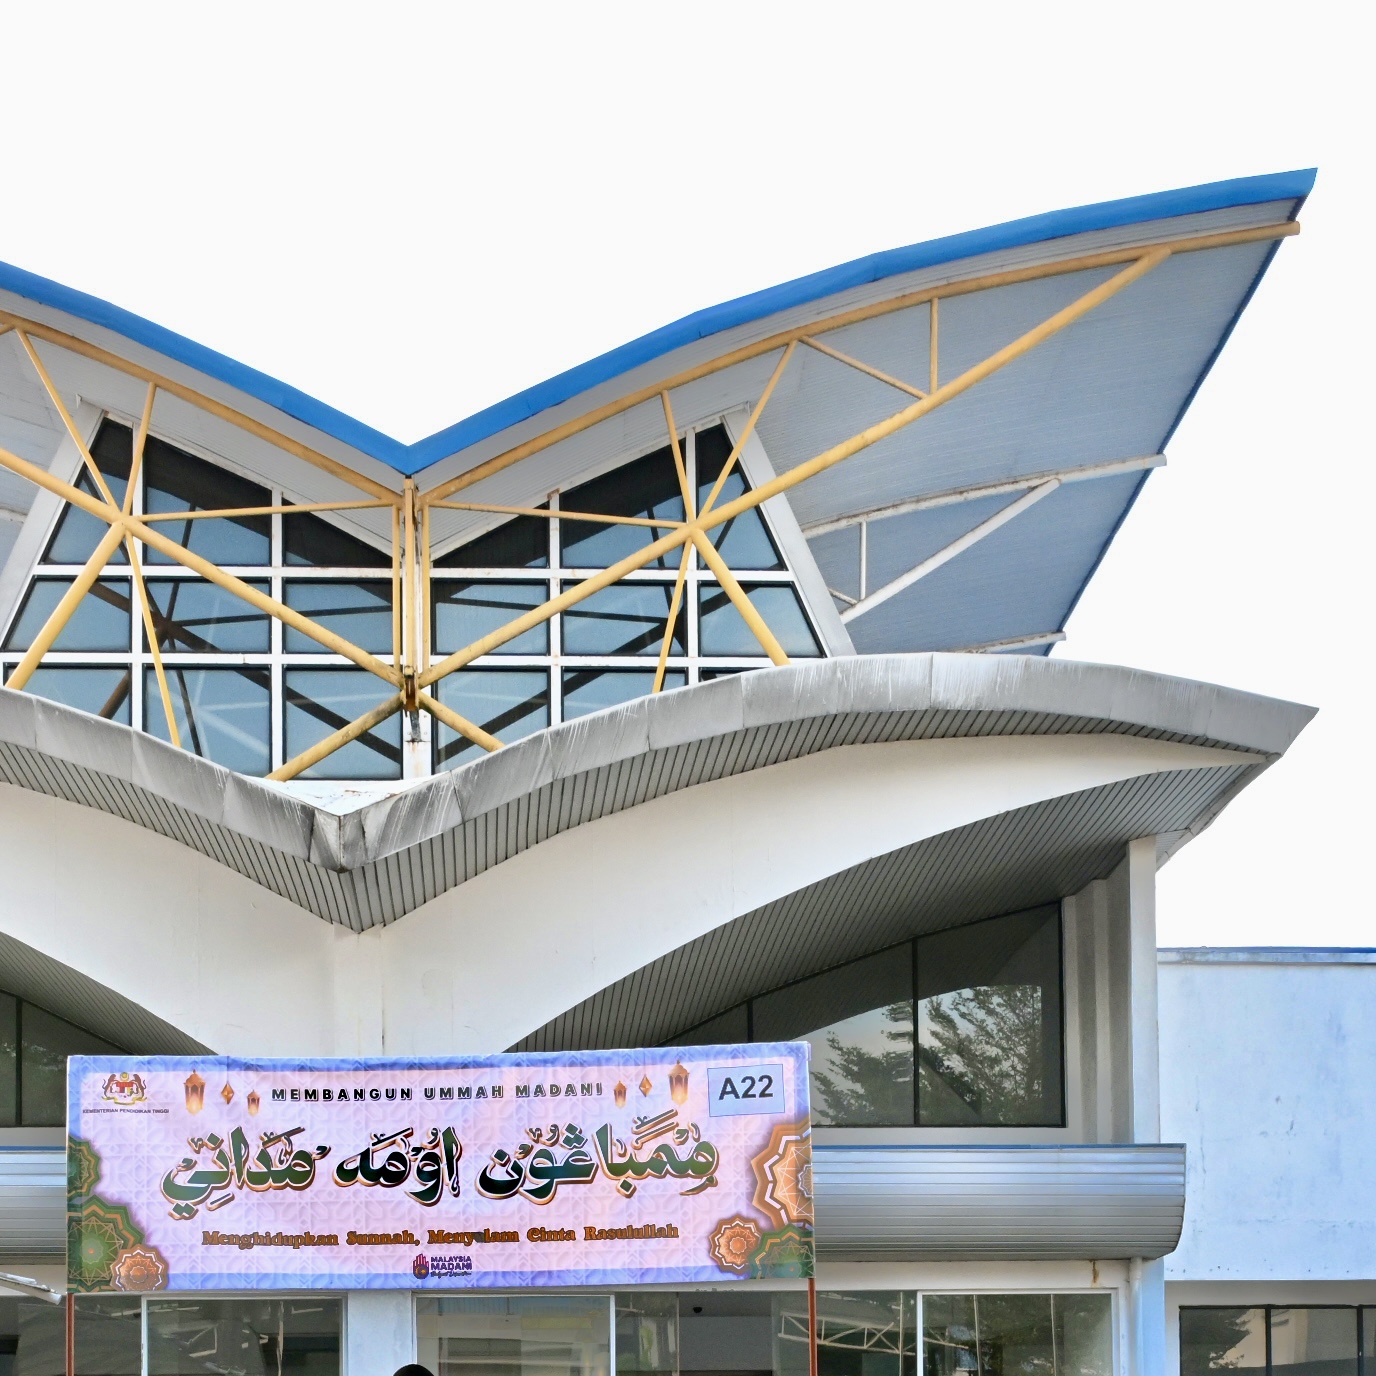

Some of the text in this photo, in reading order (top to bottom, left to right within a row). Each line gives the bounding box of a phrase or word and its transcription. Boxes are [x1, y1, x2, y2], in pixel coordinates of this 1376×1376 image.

[271, 1082, 603, 1101] MEMBANGUN UMMAH MADANI
[718, 1074, 774, 1100] A22
[202, 1230, 340, 1249] Menghidupkan
[346, 1229, 421, 1246] Sunnah,
[527, 1226, 577, 1243] Cinta
[584, 1223, 680, 1240] Rasulullah
[430, 1262, 473, 1271] MADANI
